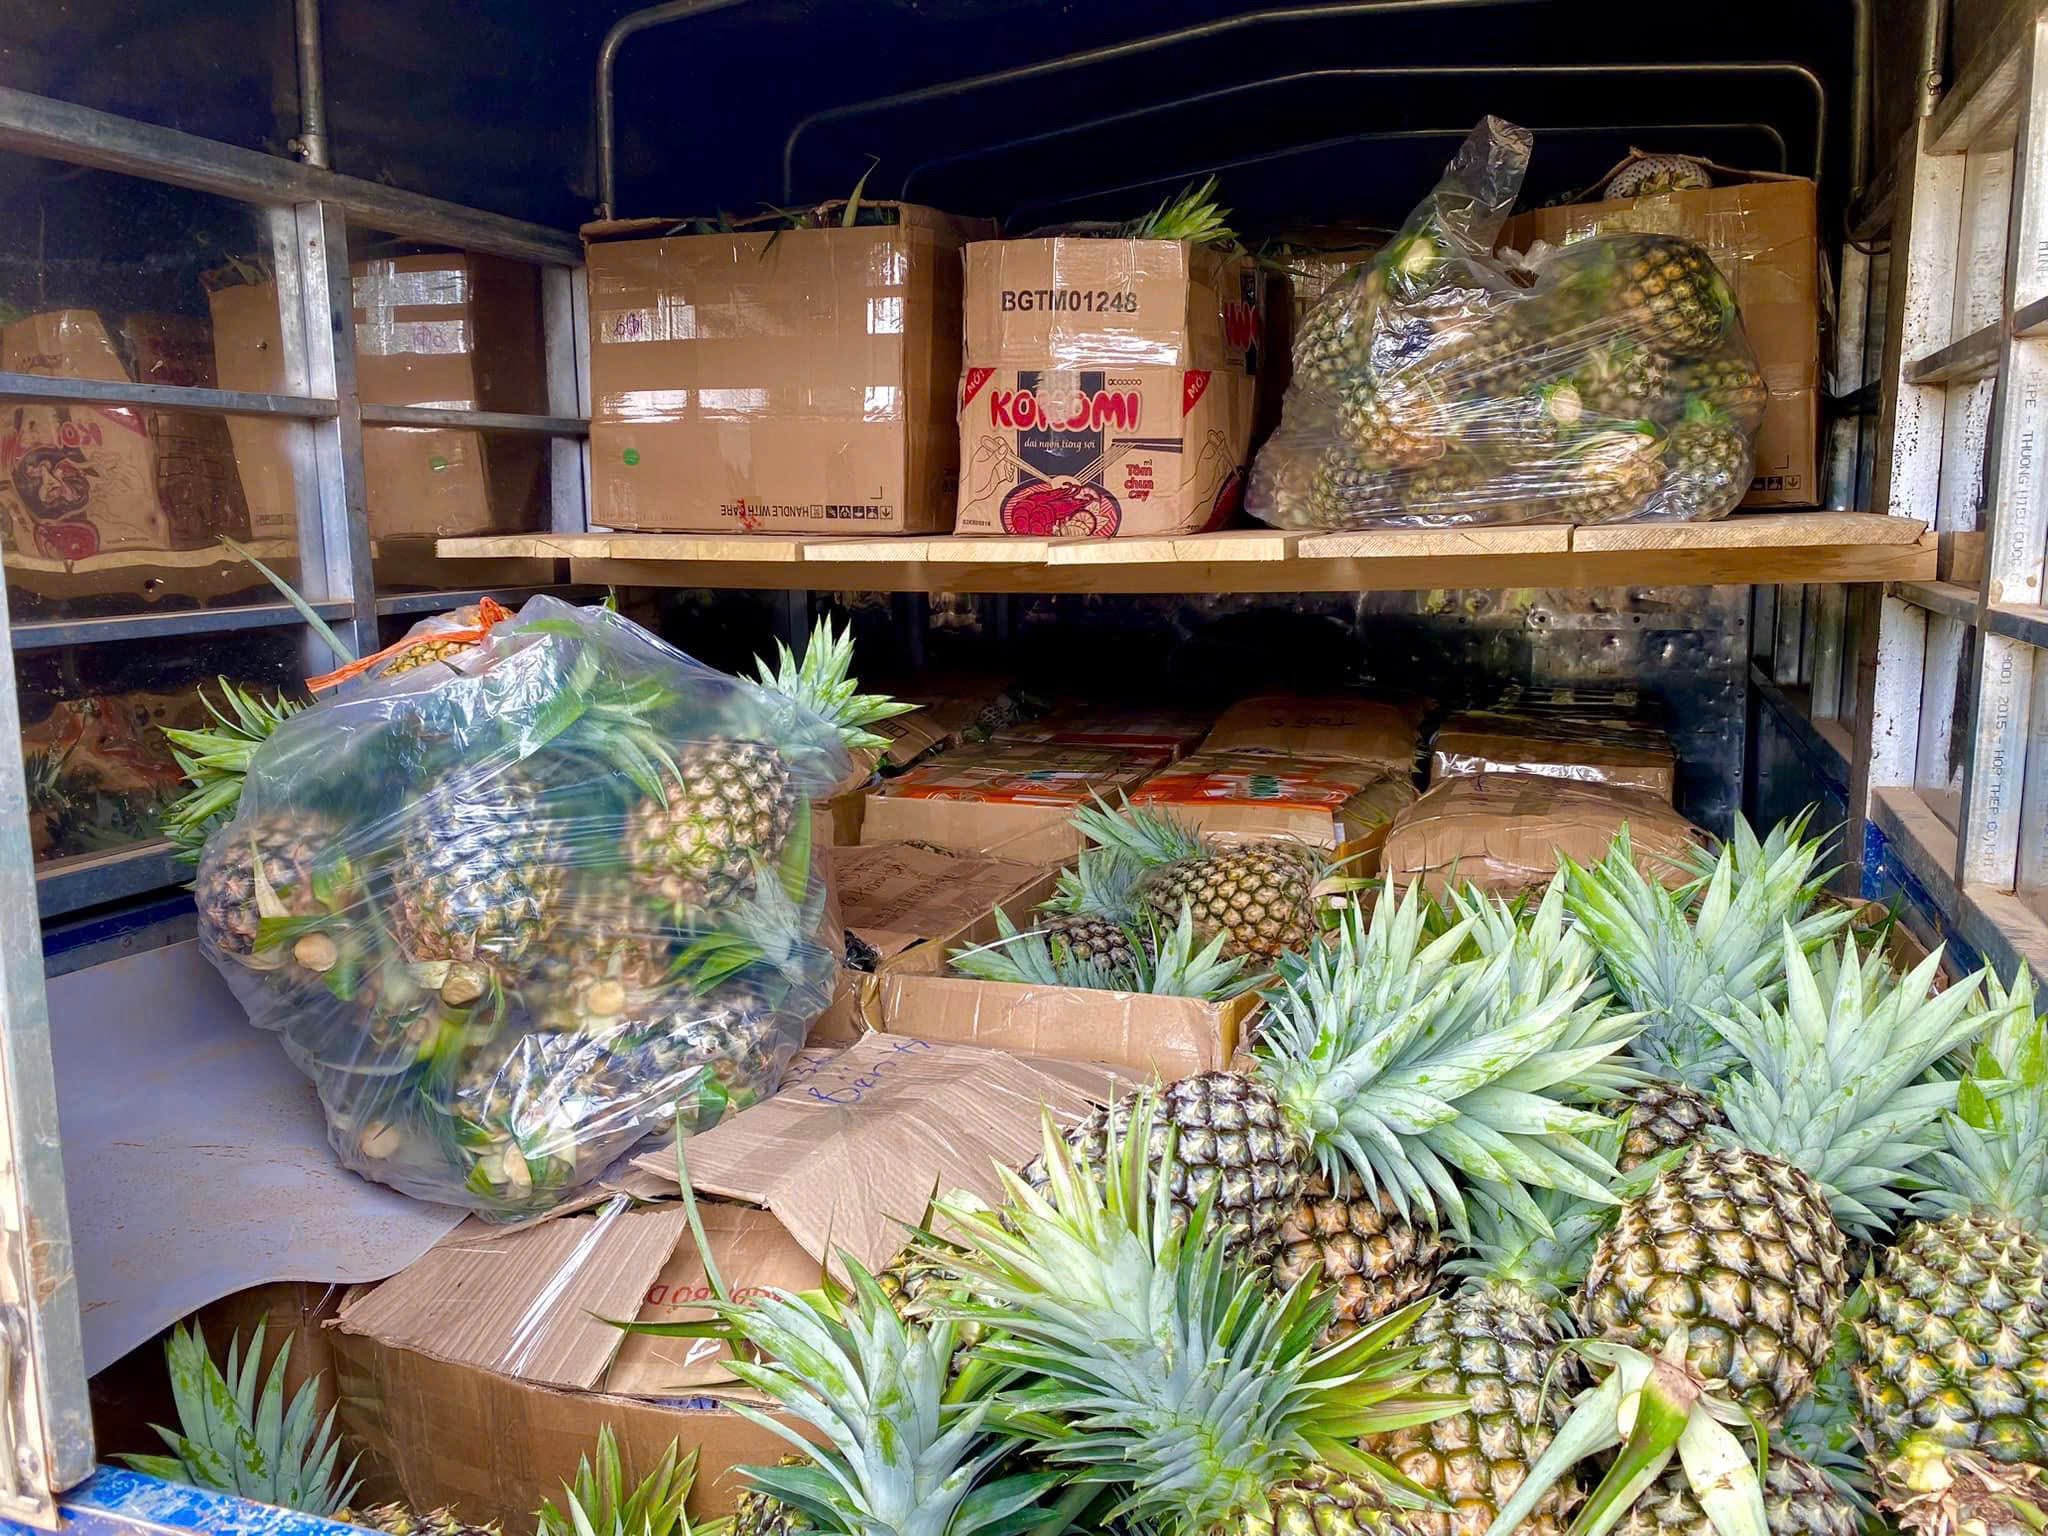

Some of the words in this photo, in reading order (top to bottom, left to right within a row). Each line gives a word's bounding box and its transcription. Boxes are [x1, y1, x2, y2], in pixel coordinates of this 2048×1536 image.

[1001, 290, 1137, 313] BGTM01248
[2018, 430, 2035, 485] THUONG
[1125, 464, 1153, 476] Tôm
[748, 504, 771, 518] WITH
[772, 504, 809, 517] HANDLE
[1996, 695, 2009, 730] 2015
[1988, 782, 2002, 816] THEP
